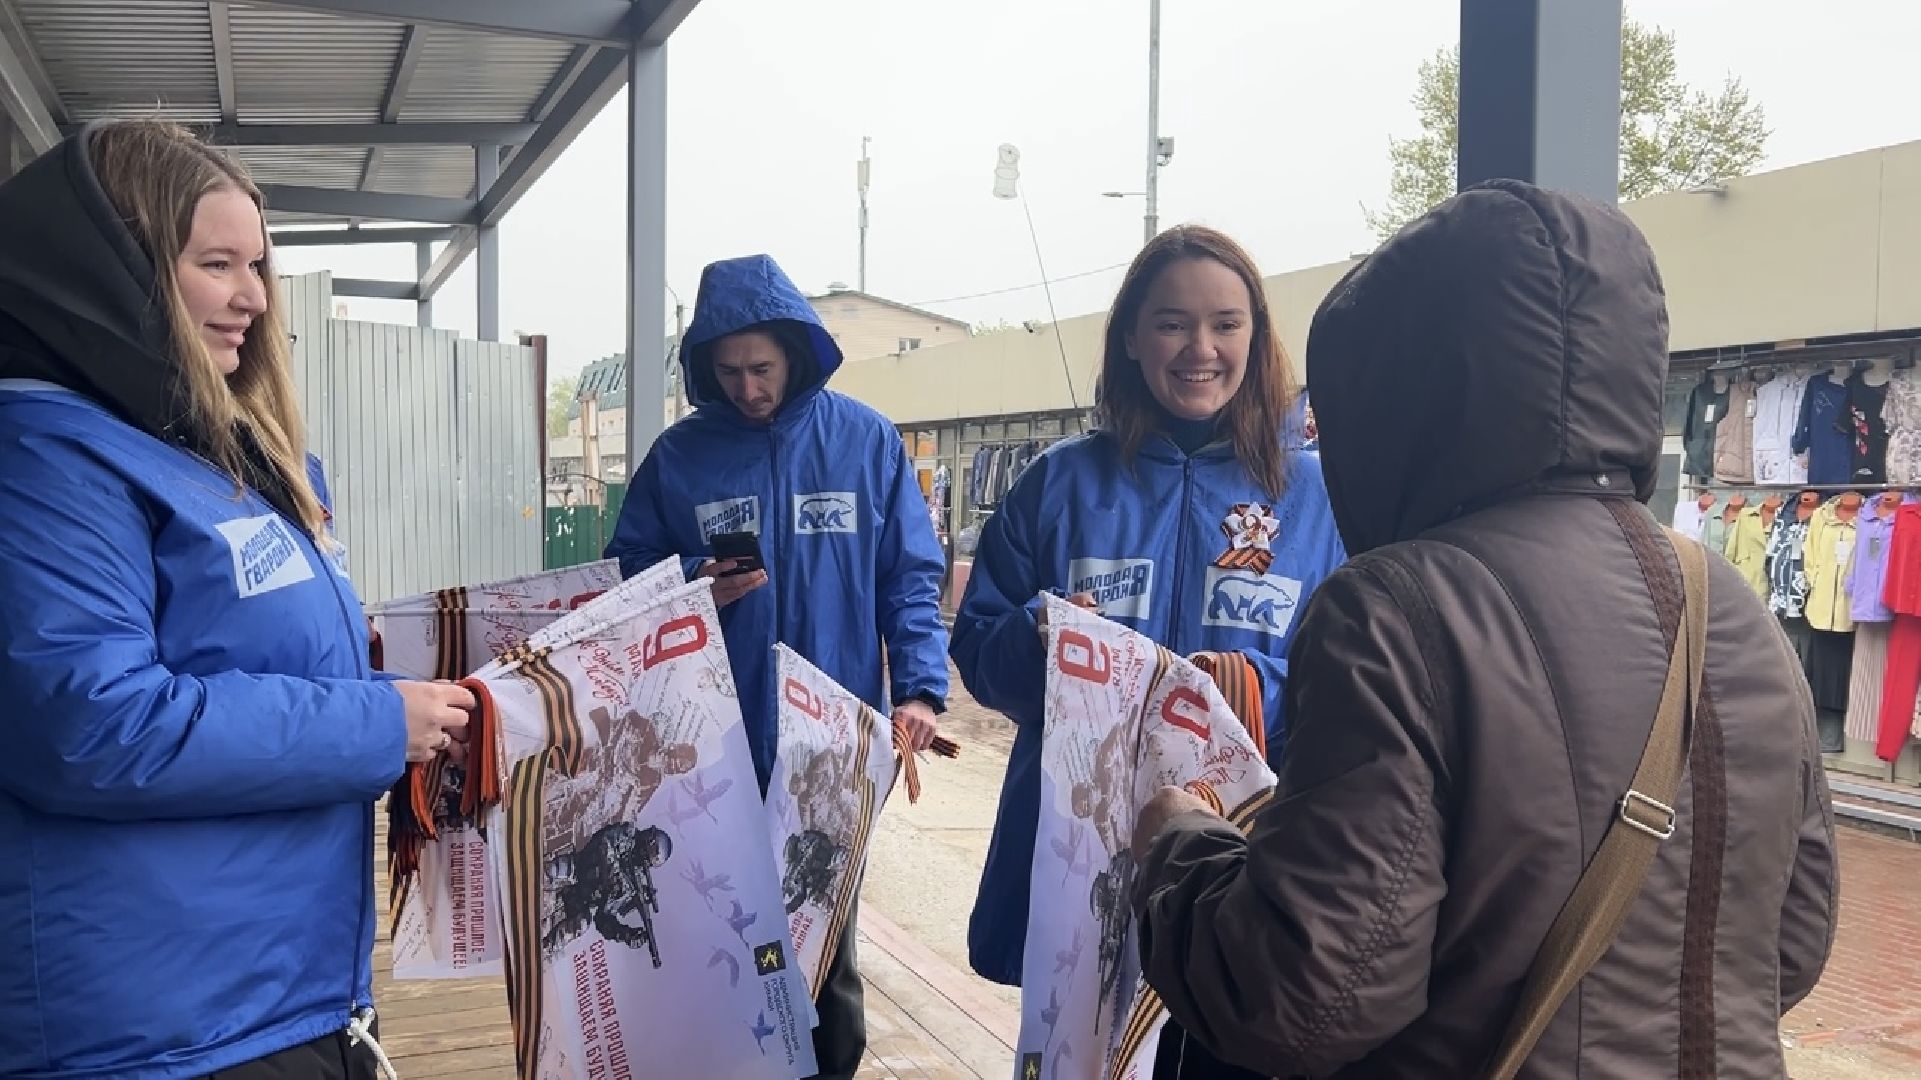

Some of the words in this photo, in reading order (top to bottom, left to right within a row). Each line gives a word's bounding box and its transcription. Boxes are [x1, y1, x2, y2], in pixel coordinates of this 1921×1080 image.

[643, 615, 708, 671] 9
[450, 842, 465, 910] ЗАЩИЩАЕМ
[468, 841, 484, 898] СОХРАНЯЯ
[451, 912, 467, 970] БУДУЩЕЕ!
[470, 900, 484, 953] ПРОШЛОЕ
[573, 949, 599, 1046] ЗАЩИЩАЕМ
[590, 940, 616, 1021] СОХРАНЯЯ
